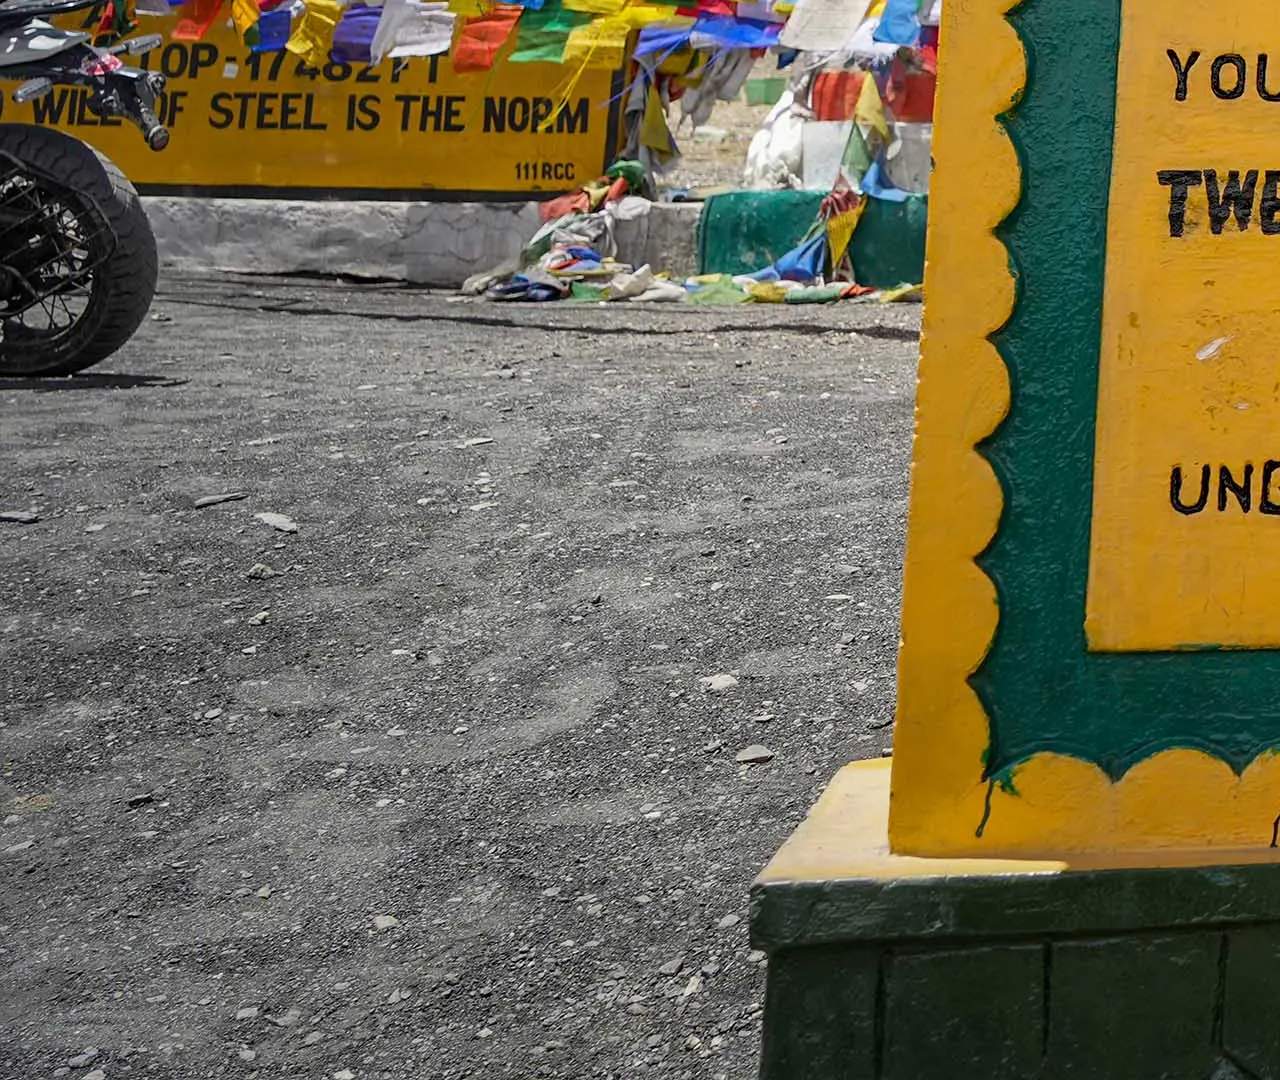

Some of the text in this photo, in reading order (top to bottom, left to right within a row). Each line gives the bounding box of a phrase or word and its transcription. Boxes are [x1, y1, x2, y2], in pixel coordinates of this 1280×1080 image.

[208, 92, 328, 131] STEEL
[346, 94, 381, 132] IS
[395, 94, 466, 133] THE
[483, 96, 590, 134] NORM
